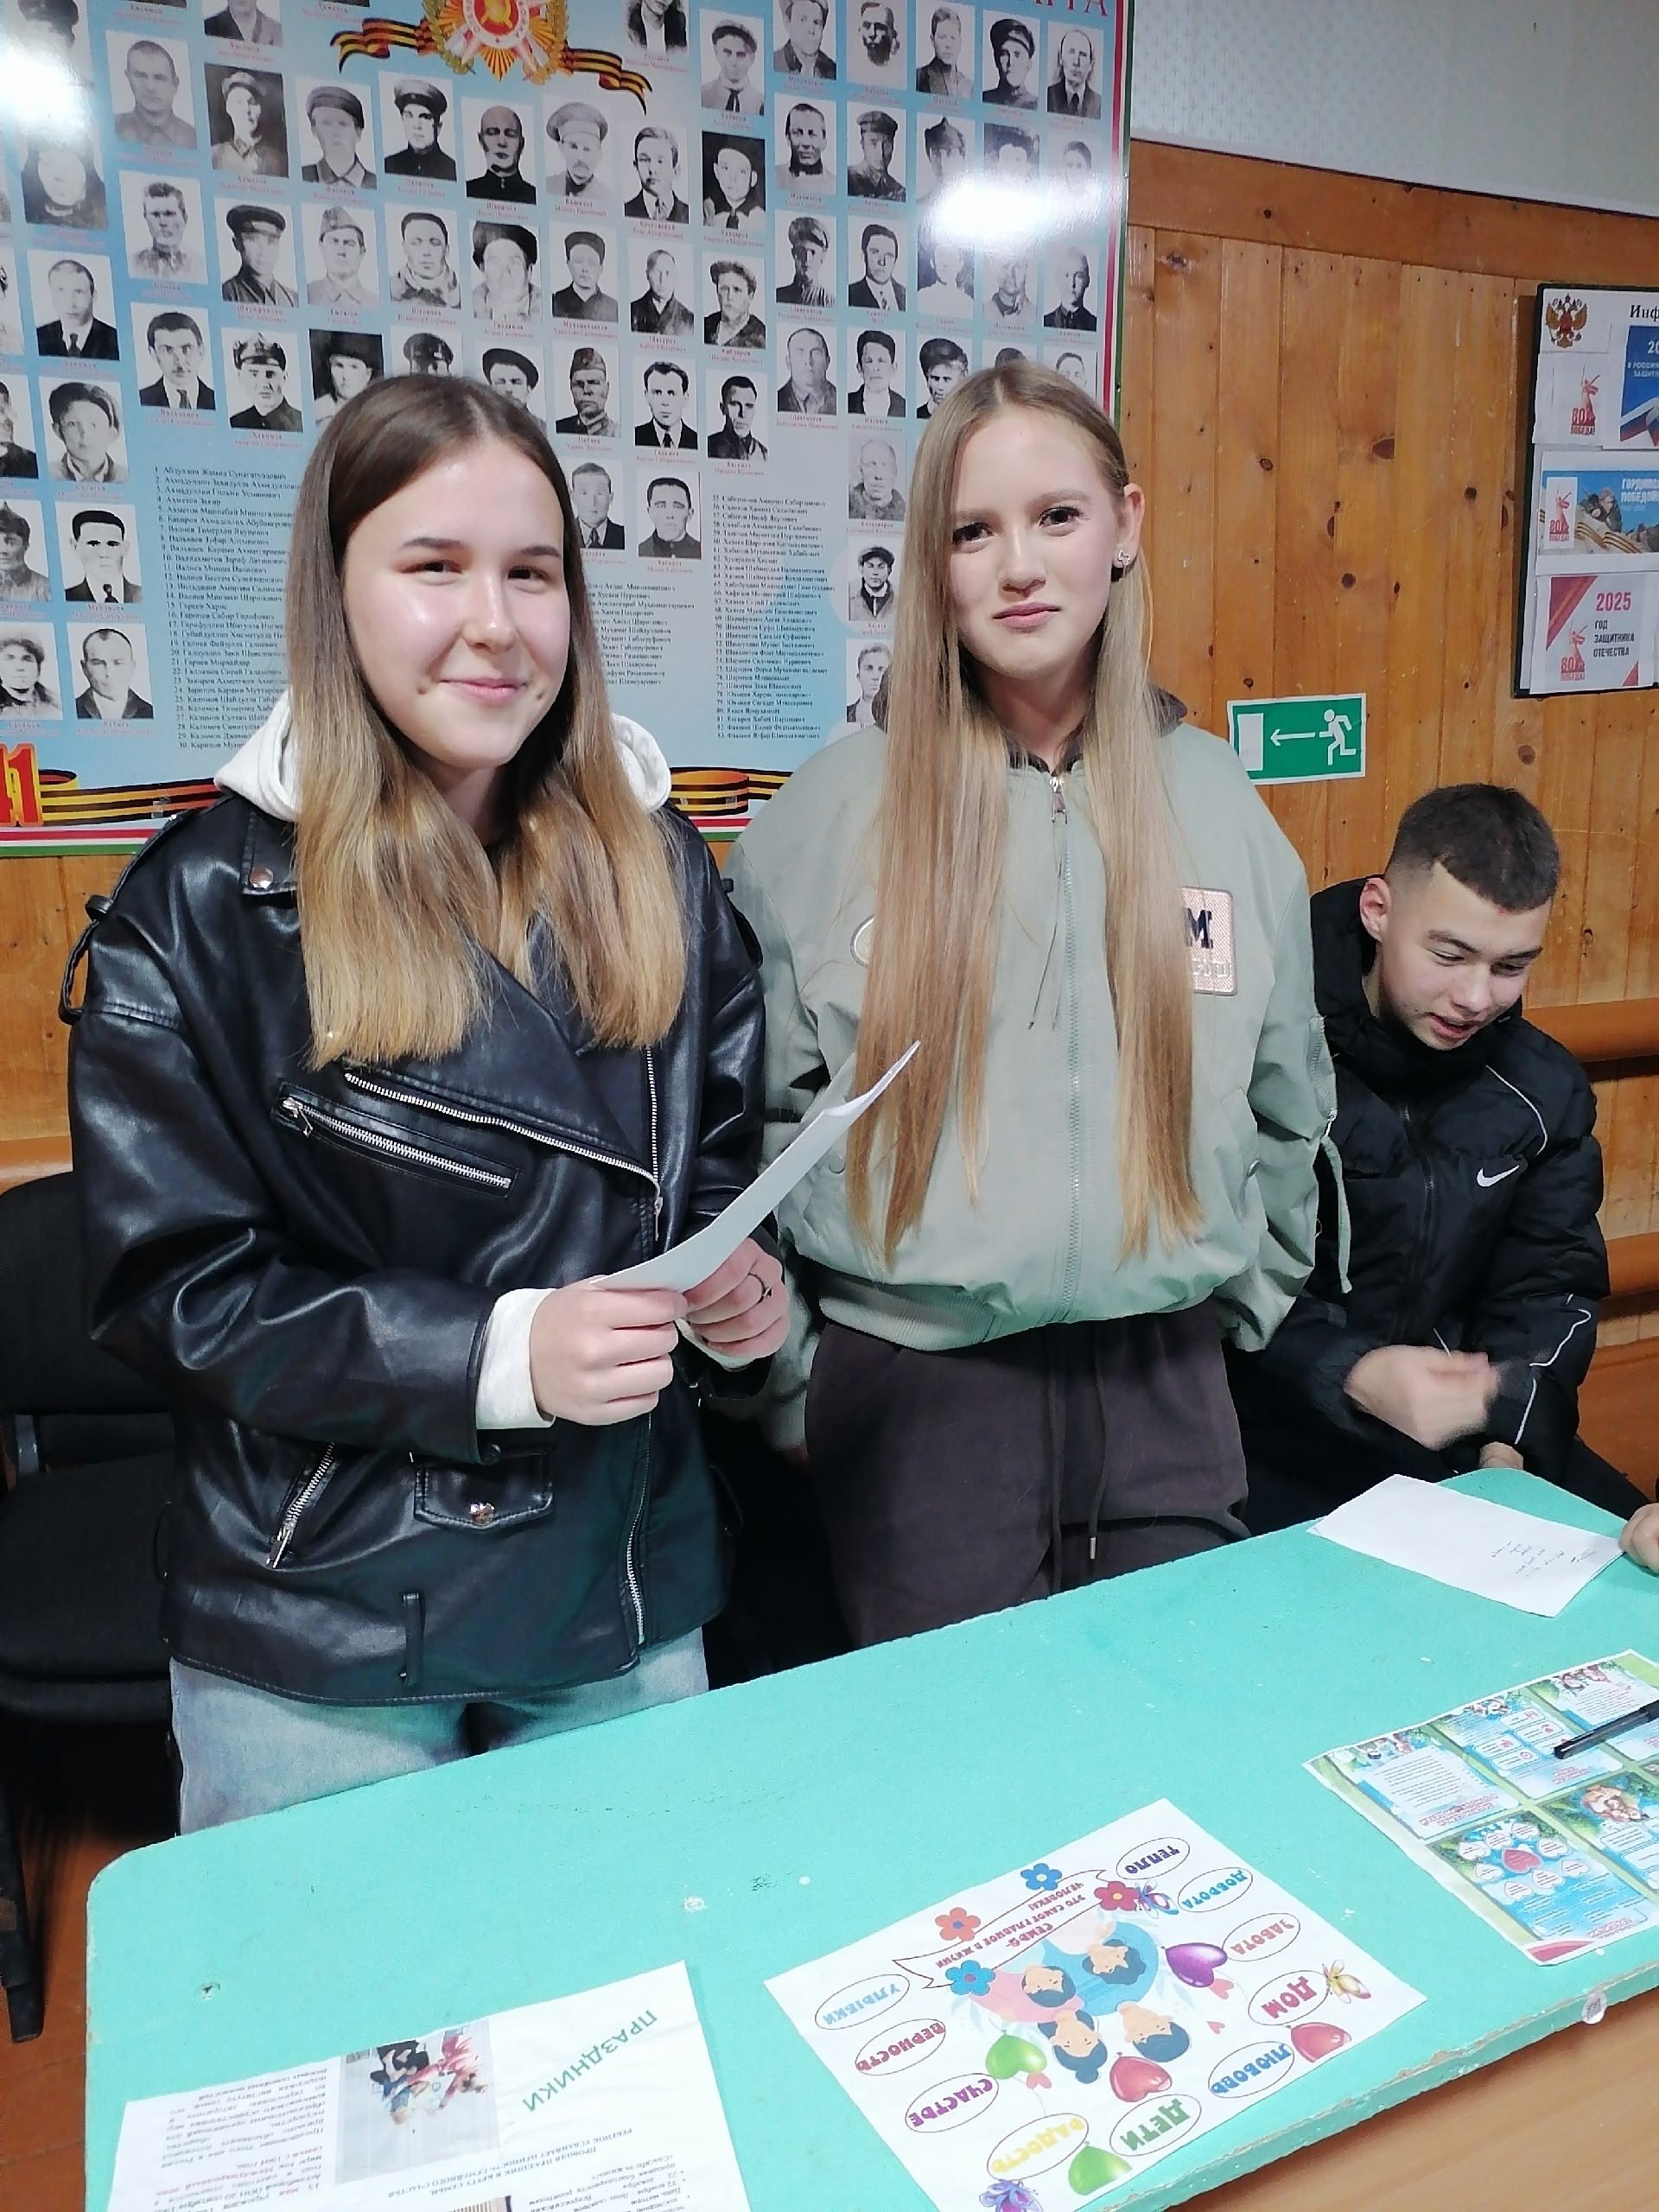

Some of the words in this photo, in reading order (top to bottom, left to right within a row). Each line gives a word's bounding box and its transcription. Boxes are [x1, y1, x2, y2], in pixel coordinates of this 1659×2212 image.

[1596, 592, 1631, 612] 2025
[1593, 632, 1635, 644] ЗАЩИТНИКА
[1594, 620, 1608, 631] ГОД
[1592, 647, 1630, 658] ОТЕЧЕСТВА
[1125, 1845, 1180, 1874] ТЕПЛО
[1065, 1892, 1085, 1907] ЭТО
[1182, 1869, 1249, 1910] ДОБРОТА
[1031, 1902, 1065, 1923] САМОЕ
[973, 1941, 982, 1950] В
[982, 1917, 1031, 1946] ГЛАВНОЕ
[1230, 1918, 1295, 1955] ЗАБОТА
[934, 1944, 975, 1969] ЖИЗНИ
[823, 1983, 900, 2025] УЛЫБКИ
[1261, 1975, 1318, 2019] ДОМ
[522, 2009, 658, 2112] ПРАЗДНИКИ
[855, 2022, 945, 2071] ВЕРНОСТЬ
[1211, 2043, 1292, 2094] ЛЮБОВЬ
[908, 2078, 993, 2127] СЧАСТЬЕ
[1119, 2098, 1192, 2151] ДЕТИ
[990, 2116, 1084, 2174] РАДОСТЬ
